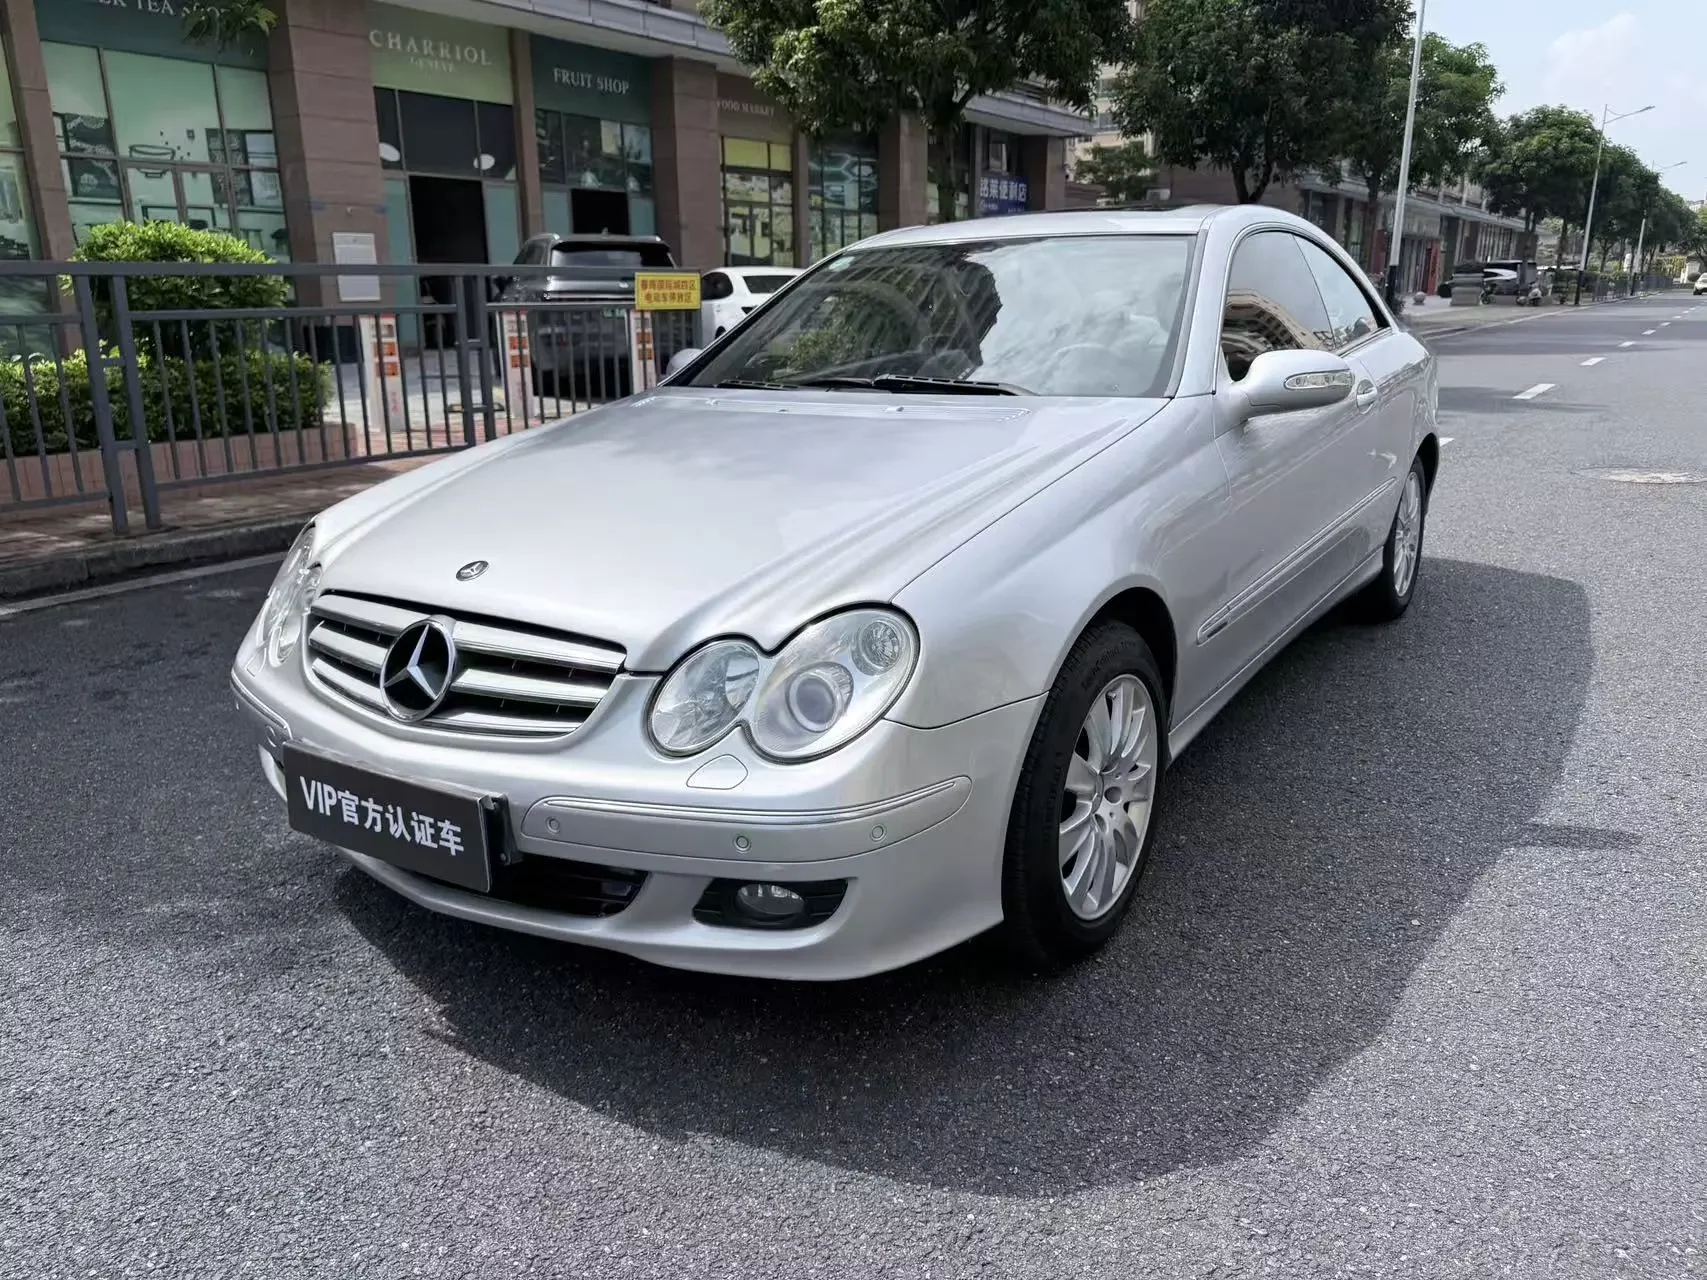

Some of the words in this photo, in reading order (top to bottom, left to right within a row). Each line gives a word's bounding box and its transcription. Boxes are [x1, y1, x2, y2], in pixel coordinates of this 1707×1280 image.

[369, 29, 492, 66] CHARRIOL
[553, 67, 592, 89] FRUIT
[596, 75, 629, 95] SHOP
[300, 775, 464, 856] VIP官方认证车
